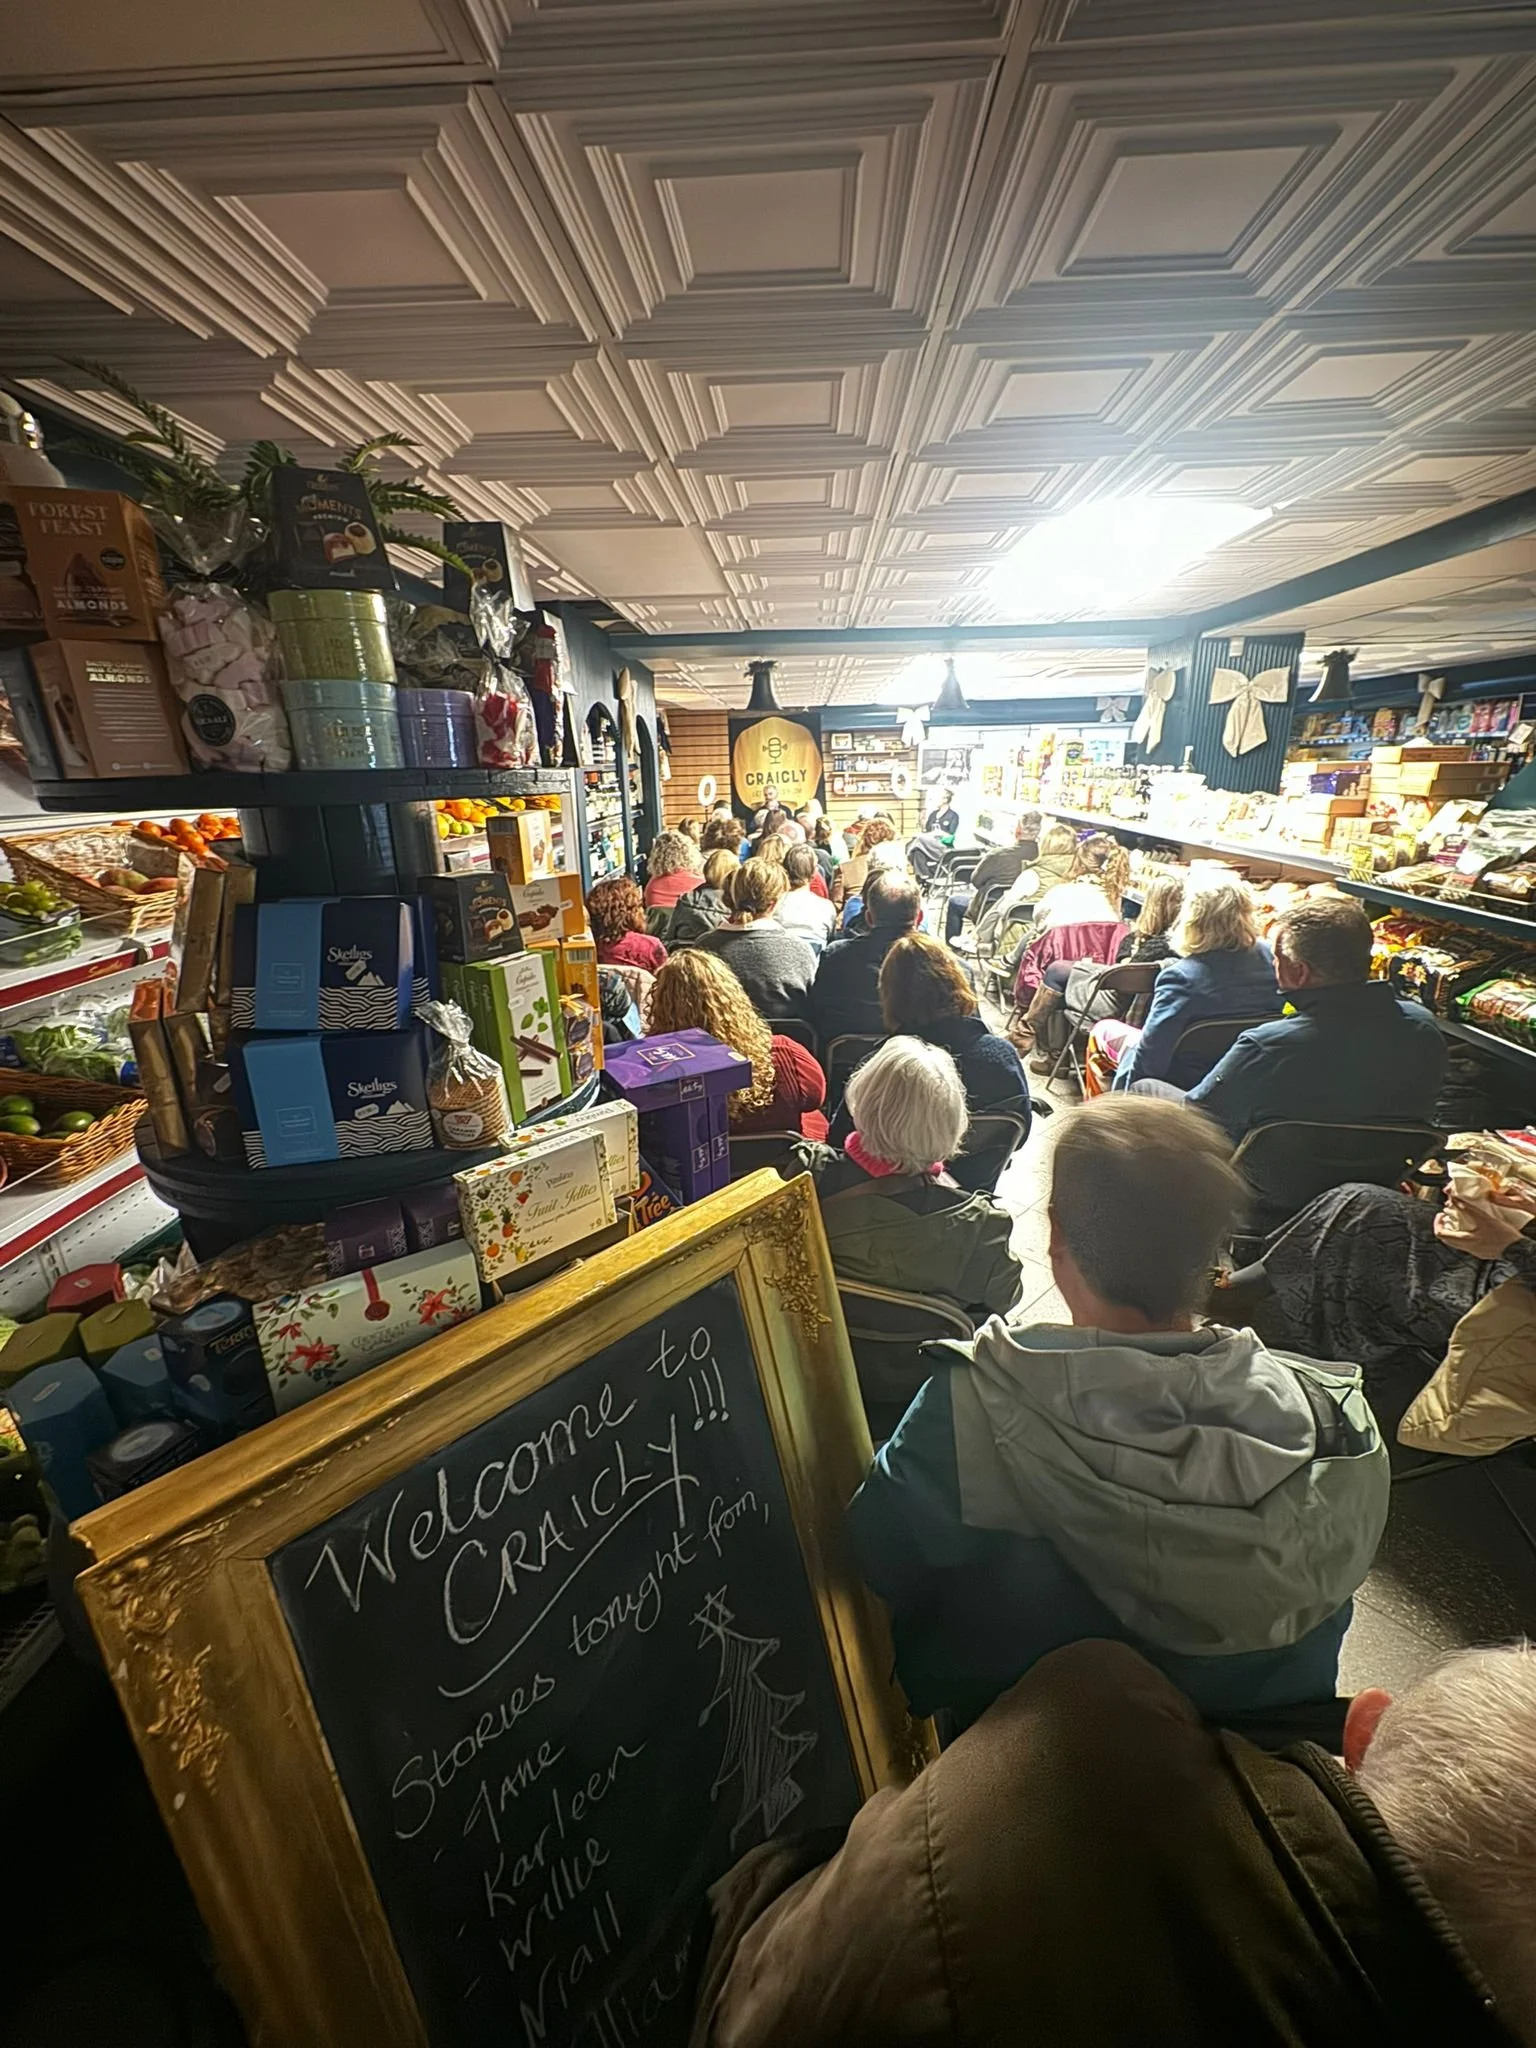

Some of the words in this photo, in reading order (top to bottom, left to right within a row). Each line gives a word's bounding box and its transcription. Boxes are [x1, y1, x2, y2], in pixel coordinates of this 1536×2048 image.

[28, 501, 109, 520] FOREST
[40, 519, 106, 536] FEAST
[56, 600, 129, 612] ALMONDS
[88, 673, 151, 683] ALMONDS
[745, 769, 807, 787] CRAICLY
[327, 944, 373, 963] Skelligs
[347, 1077, 398, 1098] Skelligs
[525, 1199, 559, 1222] Fruit
[560, 1182, 598, 1210] Jellies
[304, 1382, 638, 1613] Welcome
[646, 1326, 712, 1379] to
[568, 1529, 698, 1657] tonight
[519, 1889, 622, 2048] Niall
